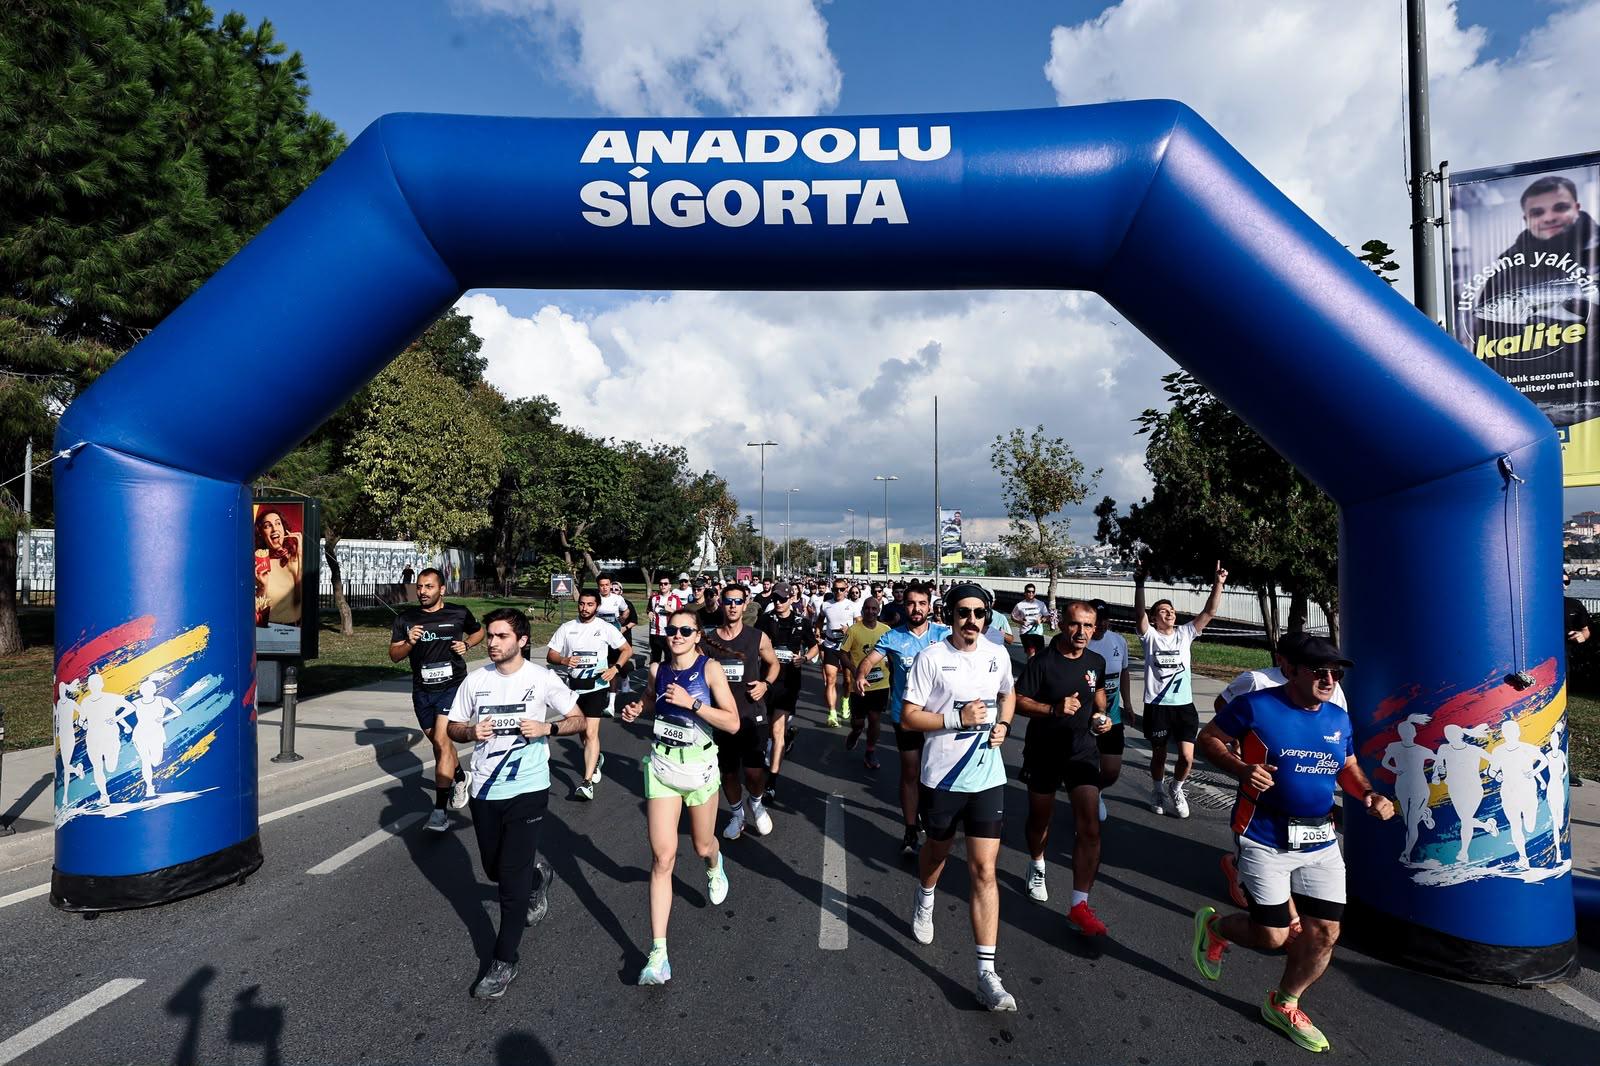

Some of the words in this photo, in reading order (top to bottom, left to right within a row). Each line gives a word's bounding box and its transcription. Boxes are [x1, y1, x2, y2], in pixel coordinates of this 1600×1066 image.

[579, 125, 951, 164] ANADOLU
[579, 165, 910, 228] SİGORTA
[1476, 322, 1586, 360] kalite
[1530, 371, 1574, 382] sezonuna
[1557, 379, 1600, 390] merhaba
[428, 670, 445, 678] 2672
[663, 727, 684, 740] 2688
[1316, 760, 1339, 769] asla
[1302, 831, 1328, 841] 2055
